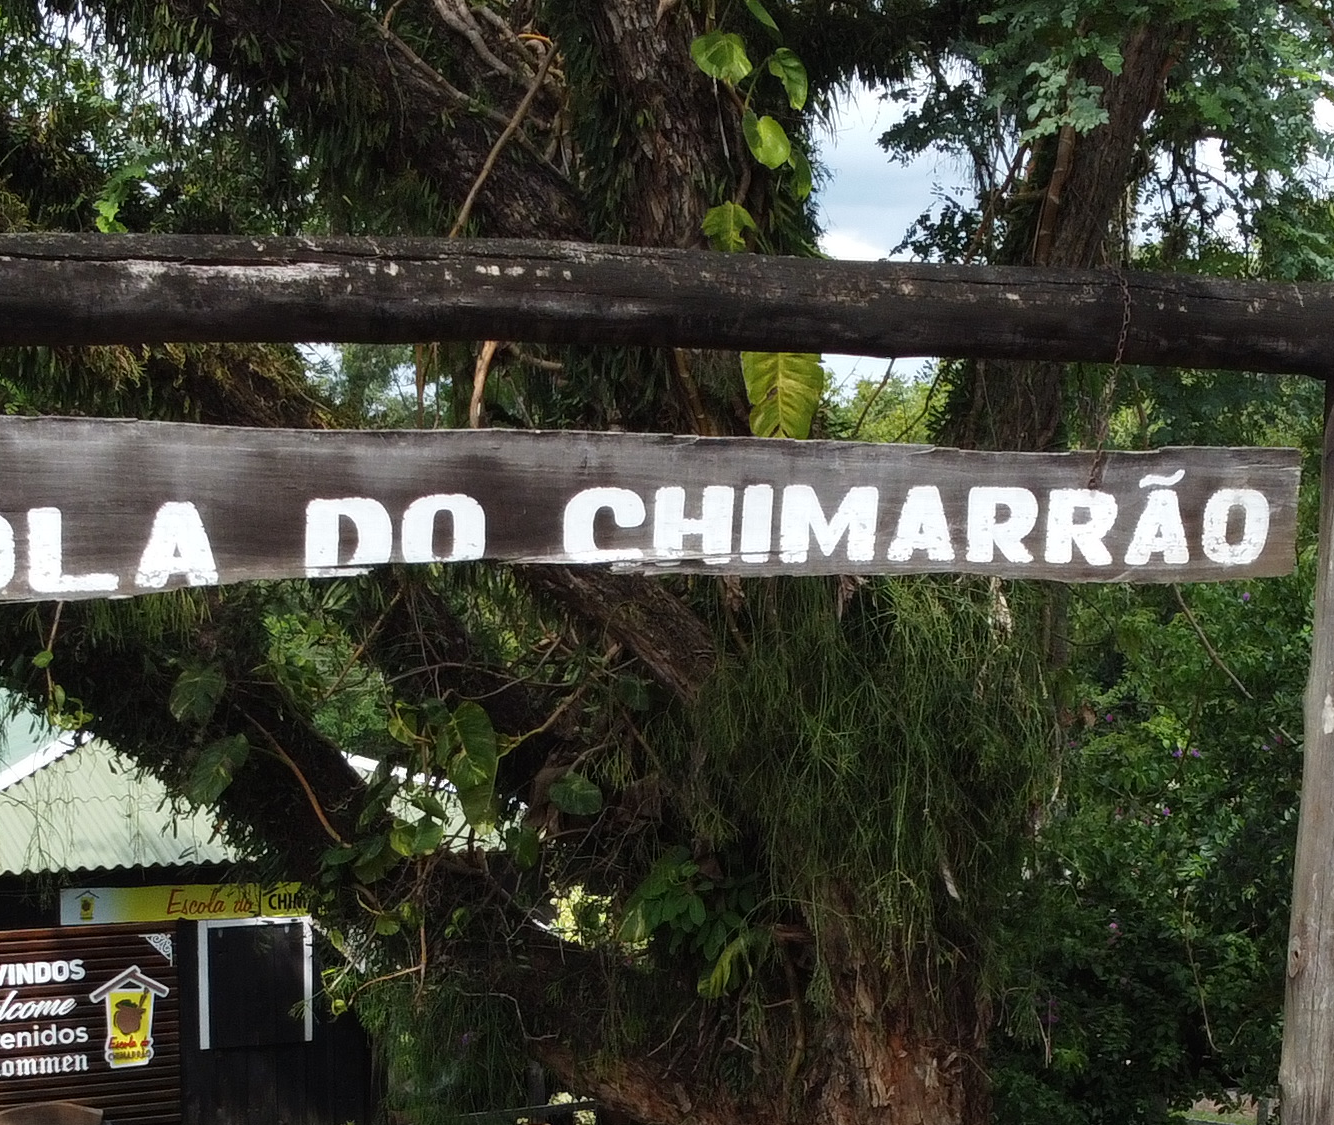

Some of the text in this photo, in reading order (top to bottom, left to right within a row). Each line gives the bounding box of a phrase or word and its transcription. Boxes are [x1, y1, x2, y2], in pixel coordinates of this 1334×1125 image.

[304, 492, 487, 578] DO
[562, 468, 1271, 566] CHIMARRÃO
[167, 887, 225, 915] Escola
